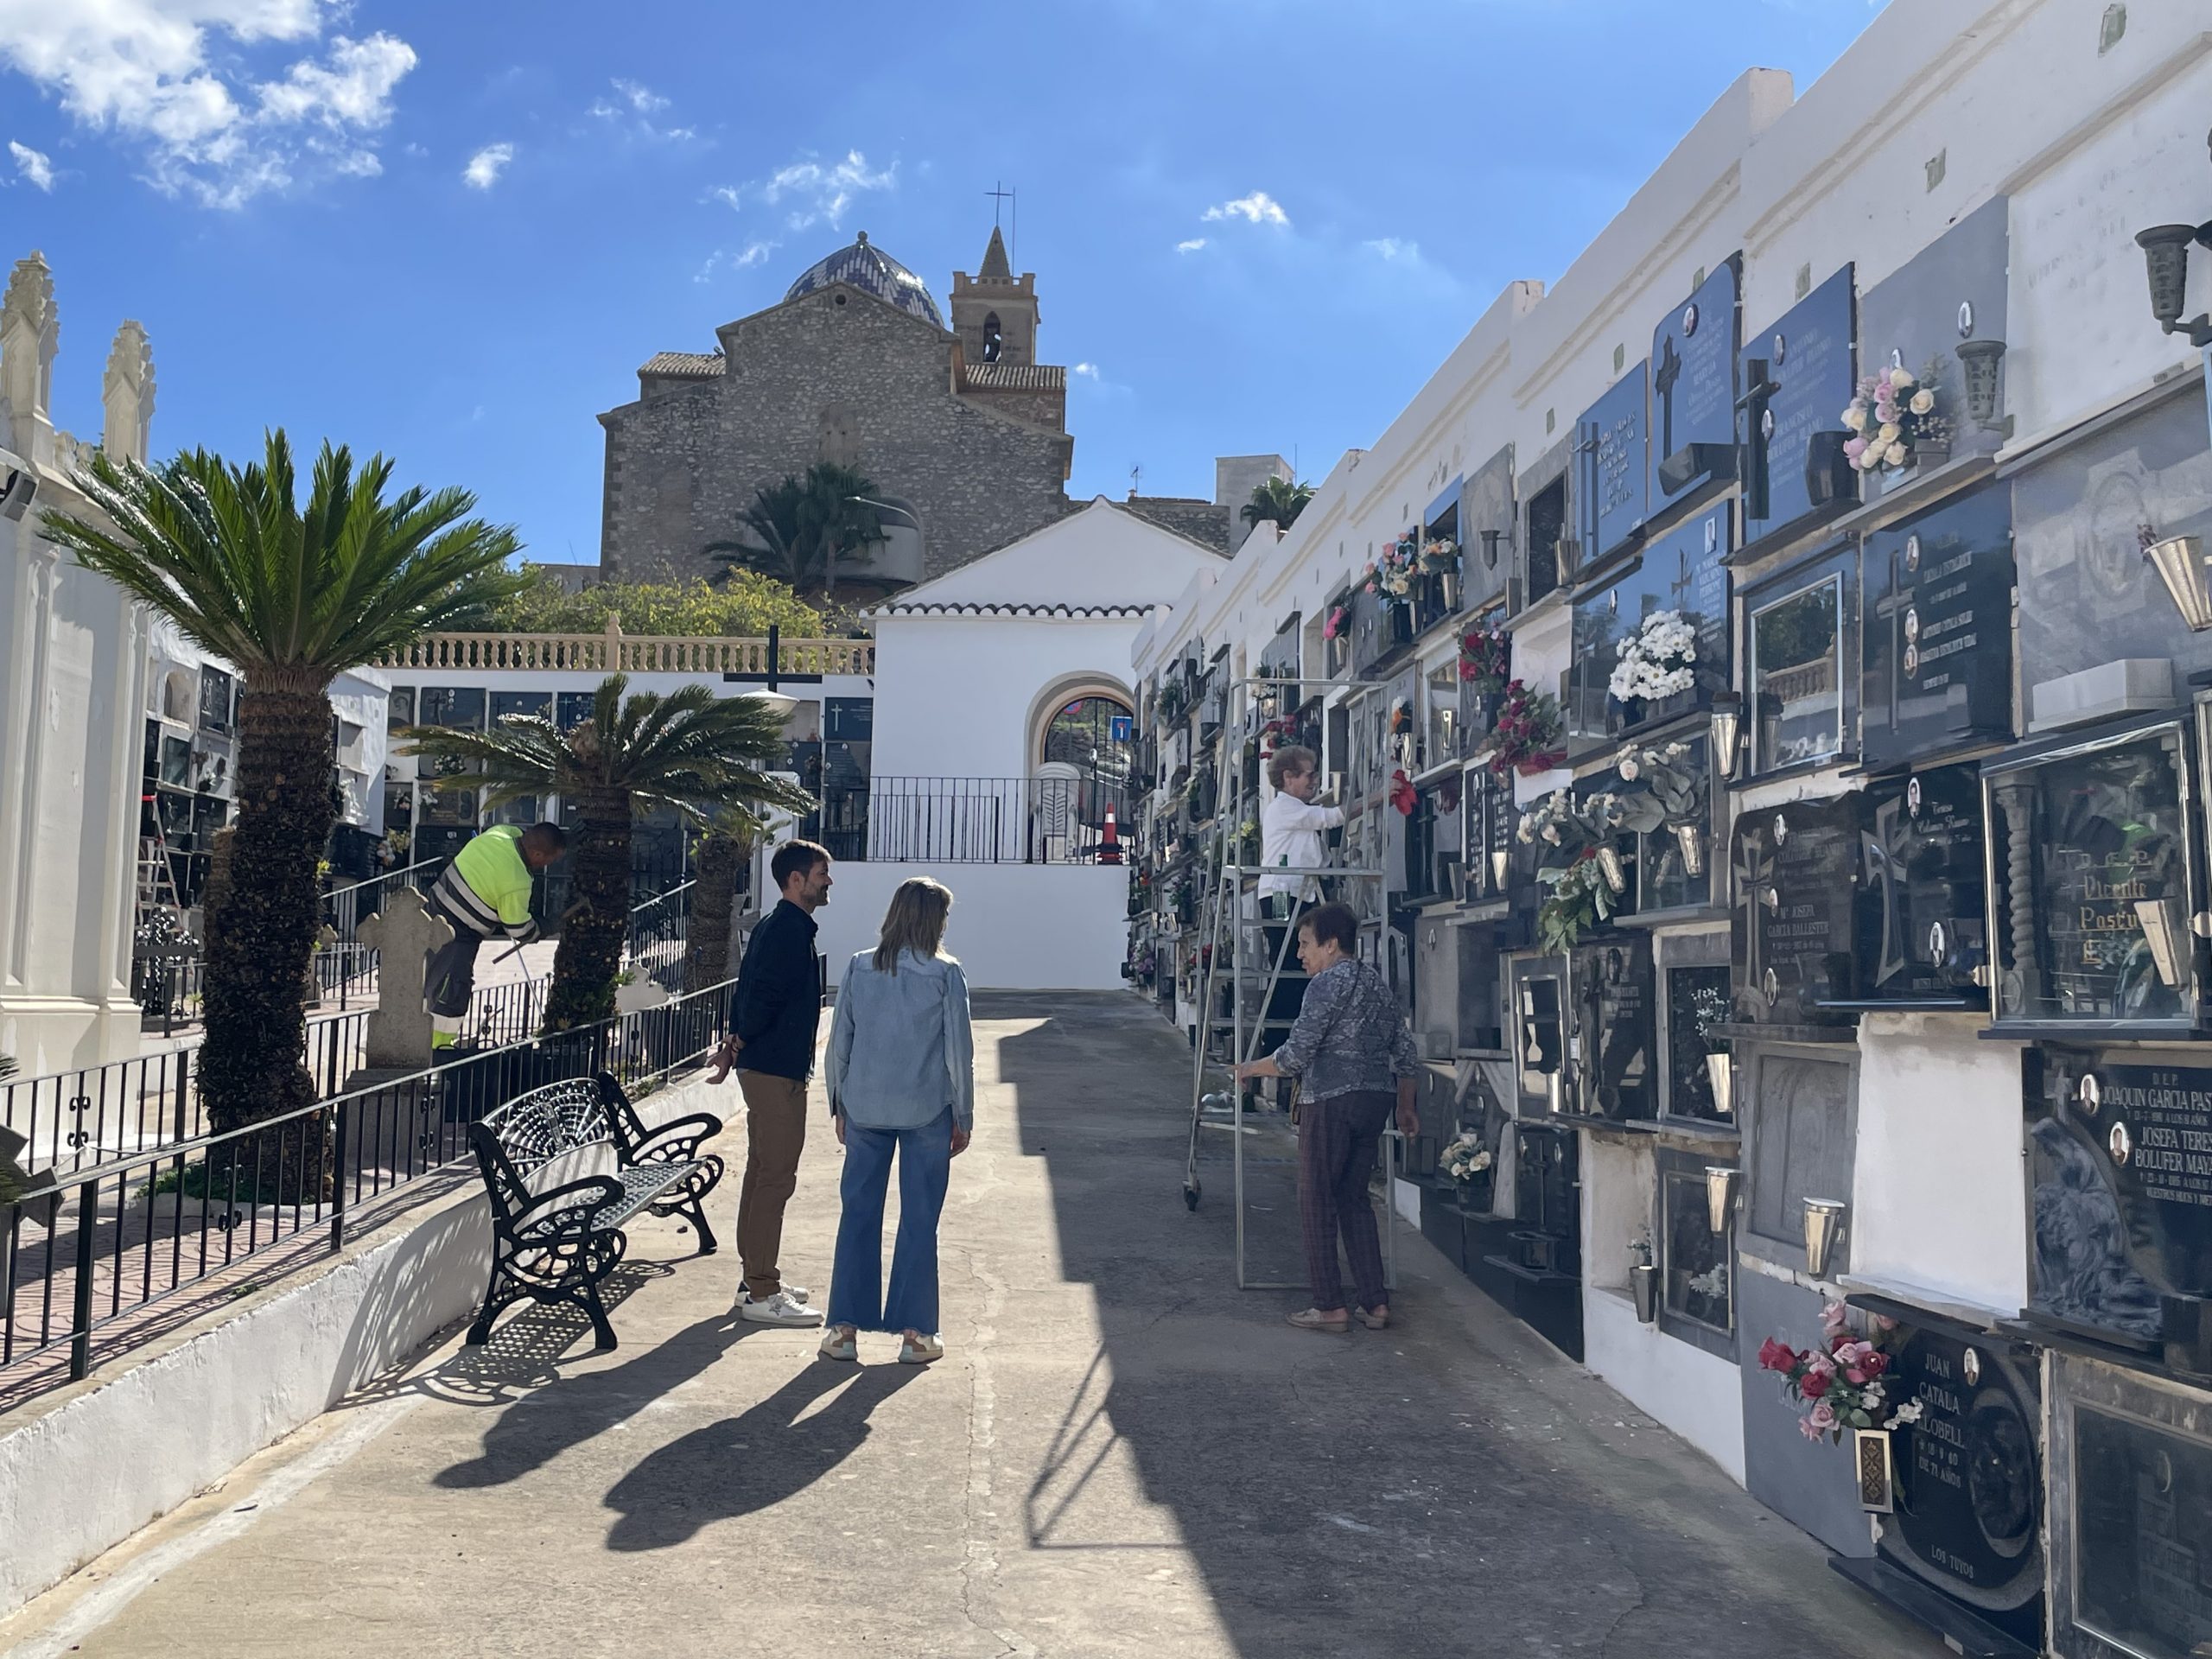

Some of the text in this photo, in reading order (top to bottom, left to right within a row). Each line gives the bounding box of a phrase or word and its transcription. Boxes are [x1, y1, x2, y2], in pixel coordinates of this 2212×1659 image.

[2103, 1086, 2146, 1109] JOAQUIN
[2148, 1089, 2189, 1110] GARCIA
[2141, 1127, 2179, 1148] JOSEFA
[2135, 1148, 2183, 1173] BOLUFER
[1924, 1353, 1950, 1379] JUAN
[1919, 1382, 1961, 1415] CATALA
[1931, 1544, 1946, 1564] LOS
